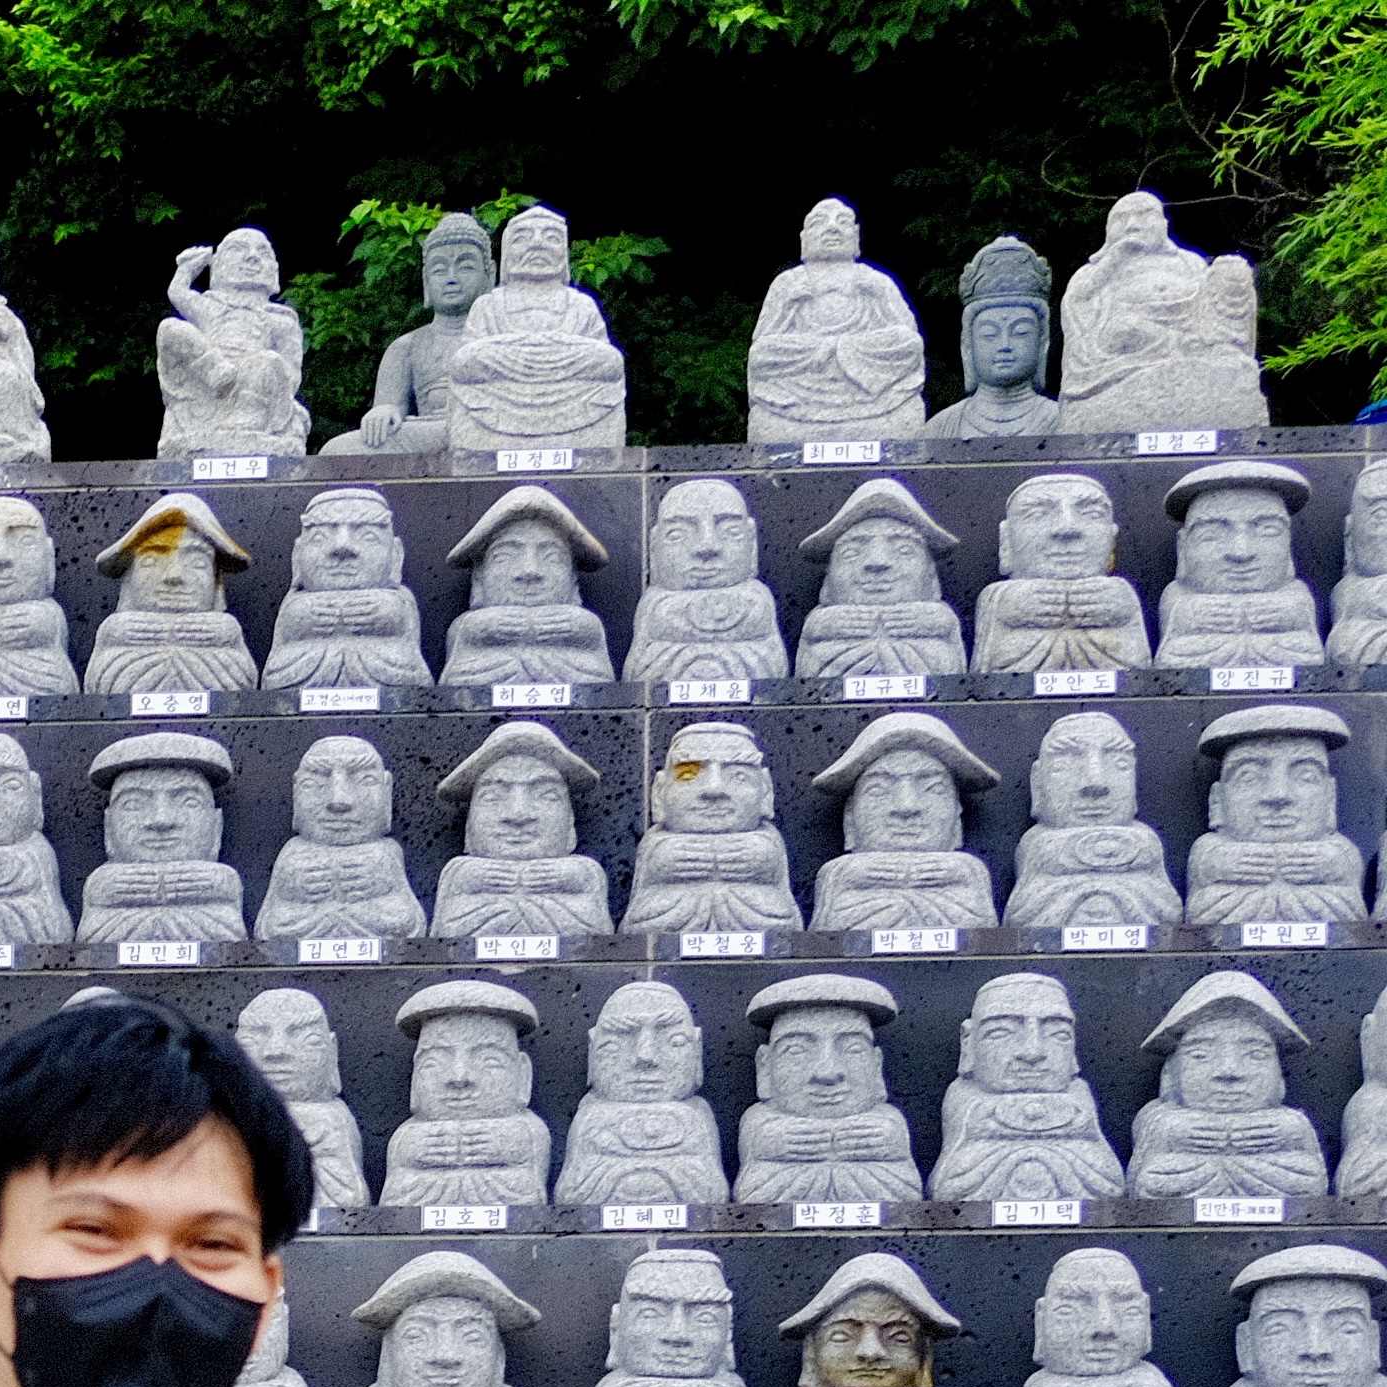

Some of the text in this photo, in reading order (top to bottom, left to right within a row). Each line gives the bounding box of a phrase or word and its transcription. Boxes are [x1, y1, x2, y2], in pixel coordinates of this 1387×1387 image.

[609, 1207, 681, 1226] 김혜민
[800, 1205, 875, 1225] 박정훈
[1002, 1203, 1074, 1222] 김기택
